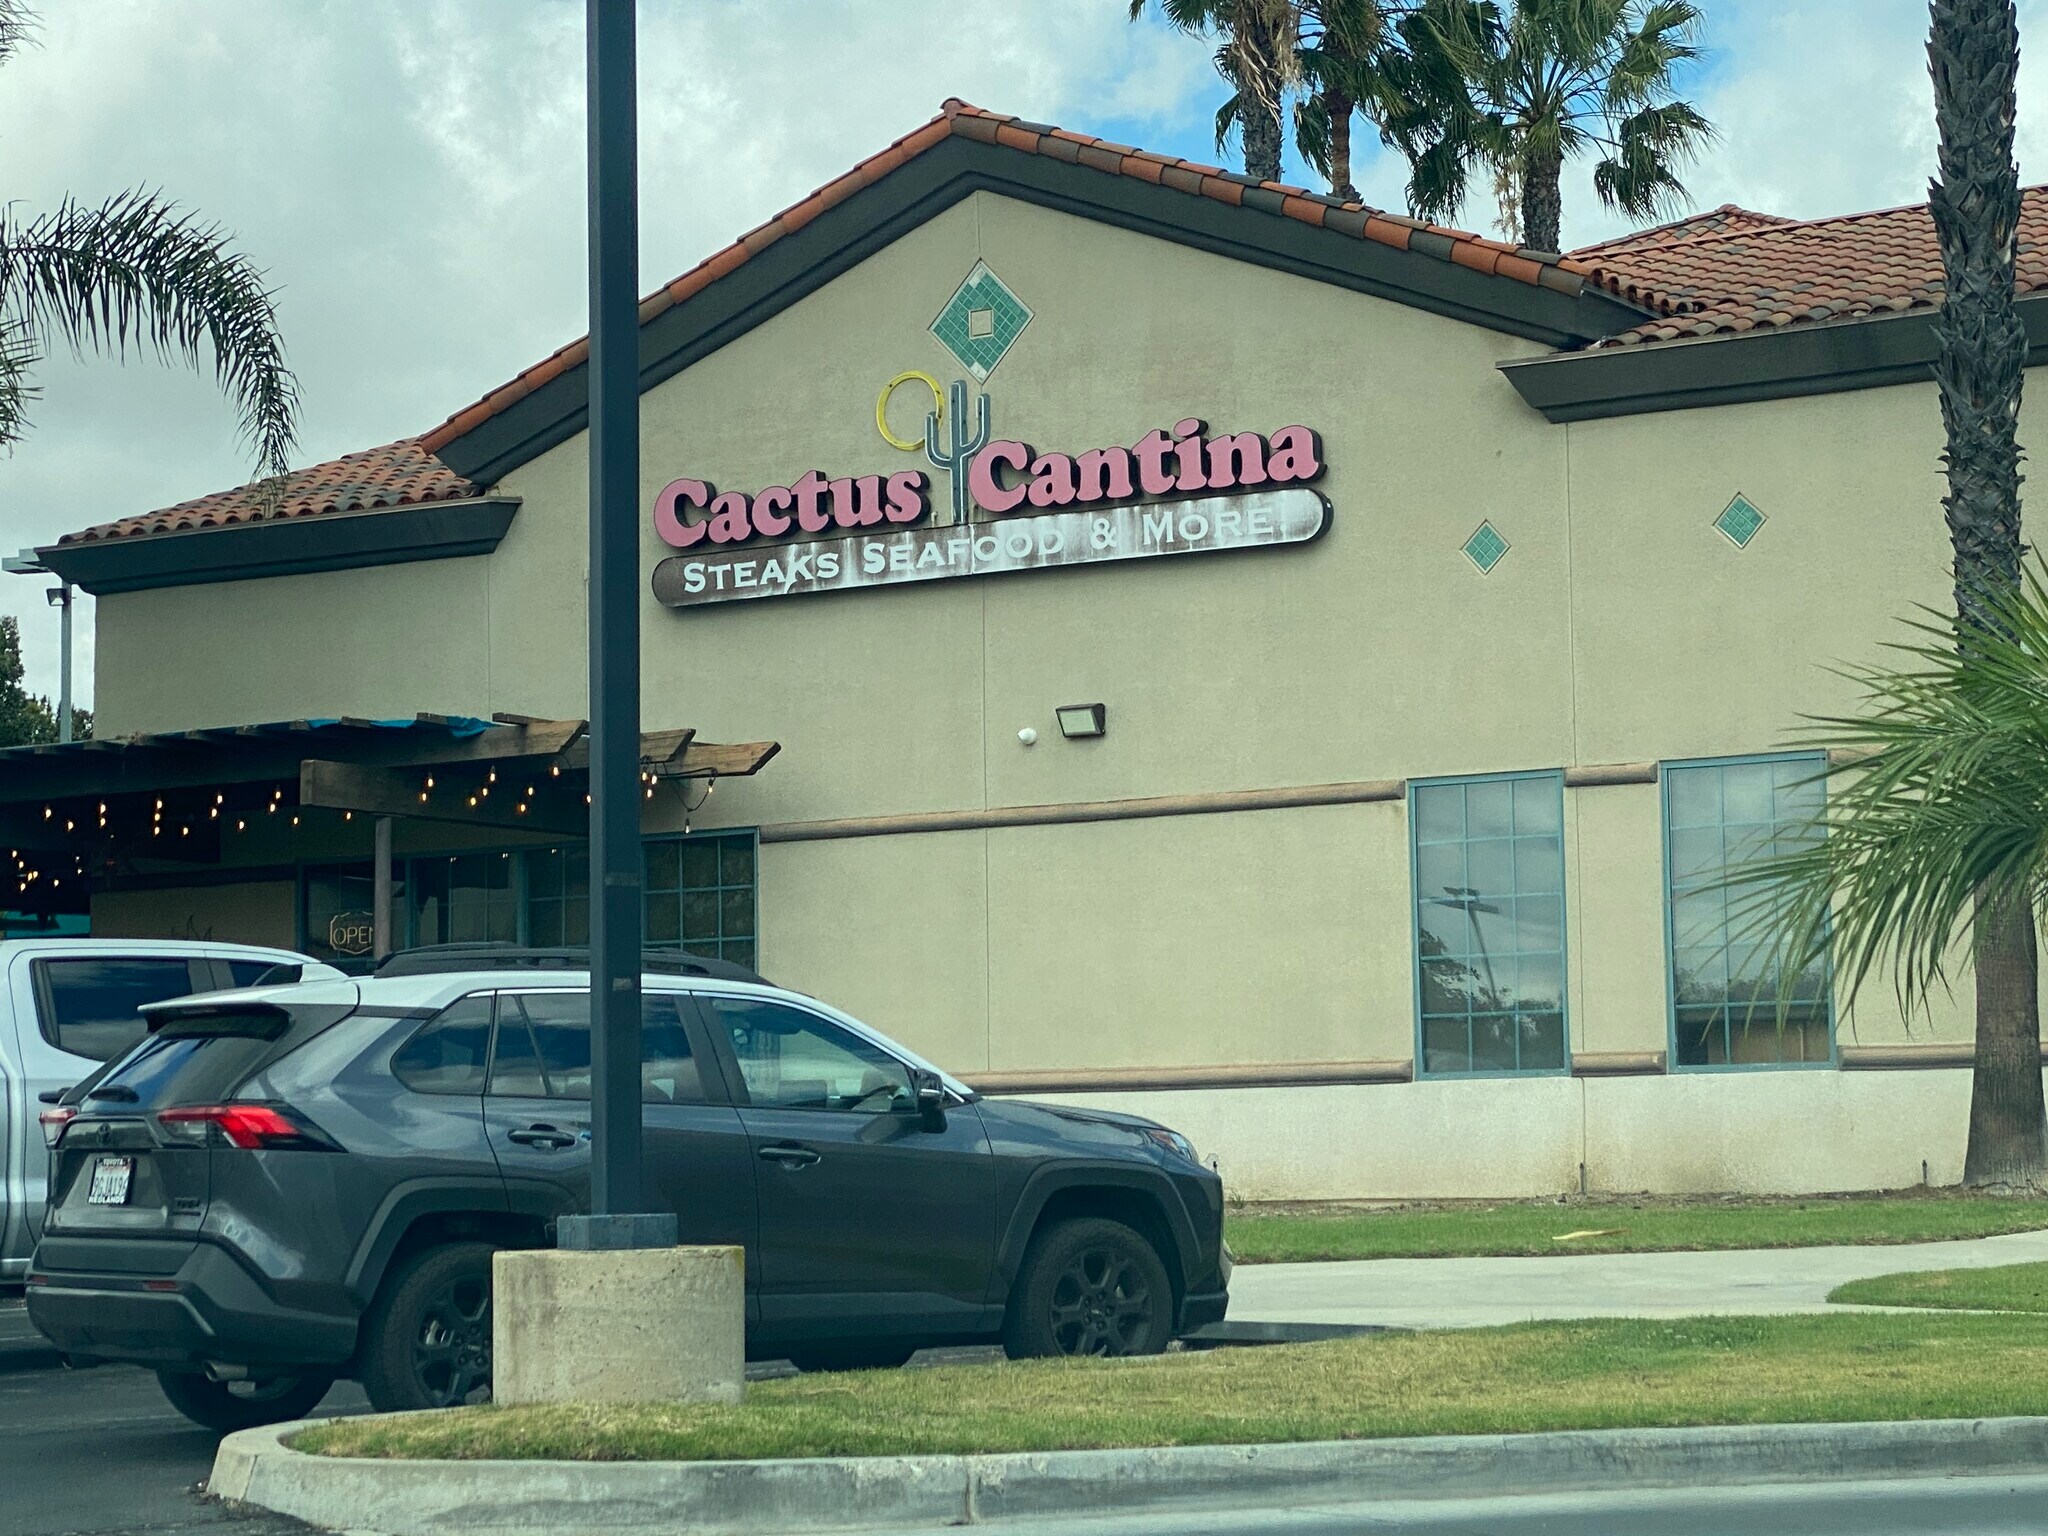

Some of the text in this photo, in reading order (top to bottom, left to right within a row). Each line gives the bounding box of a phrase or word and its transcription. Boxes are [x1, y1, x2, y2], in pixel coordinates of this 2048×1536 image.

[653, 416, 1324, 548] Cactus Cantina
[683, 552, 841, 594] STEAKS
[862, 529, 1065, 575] SEAFOOD
[1089, 517, 1118, 550] &
